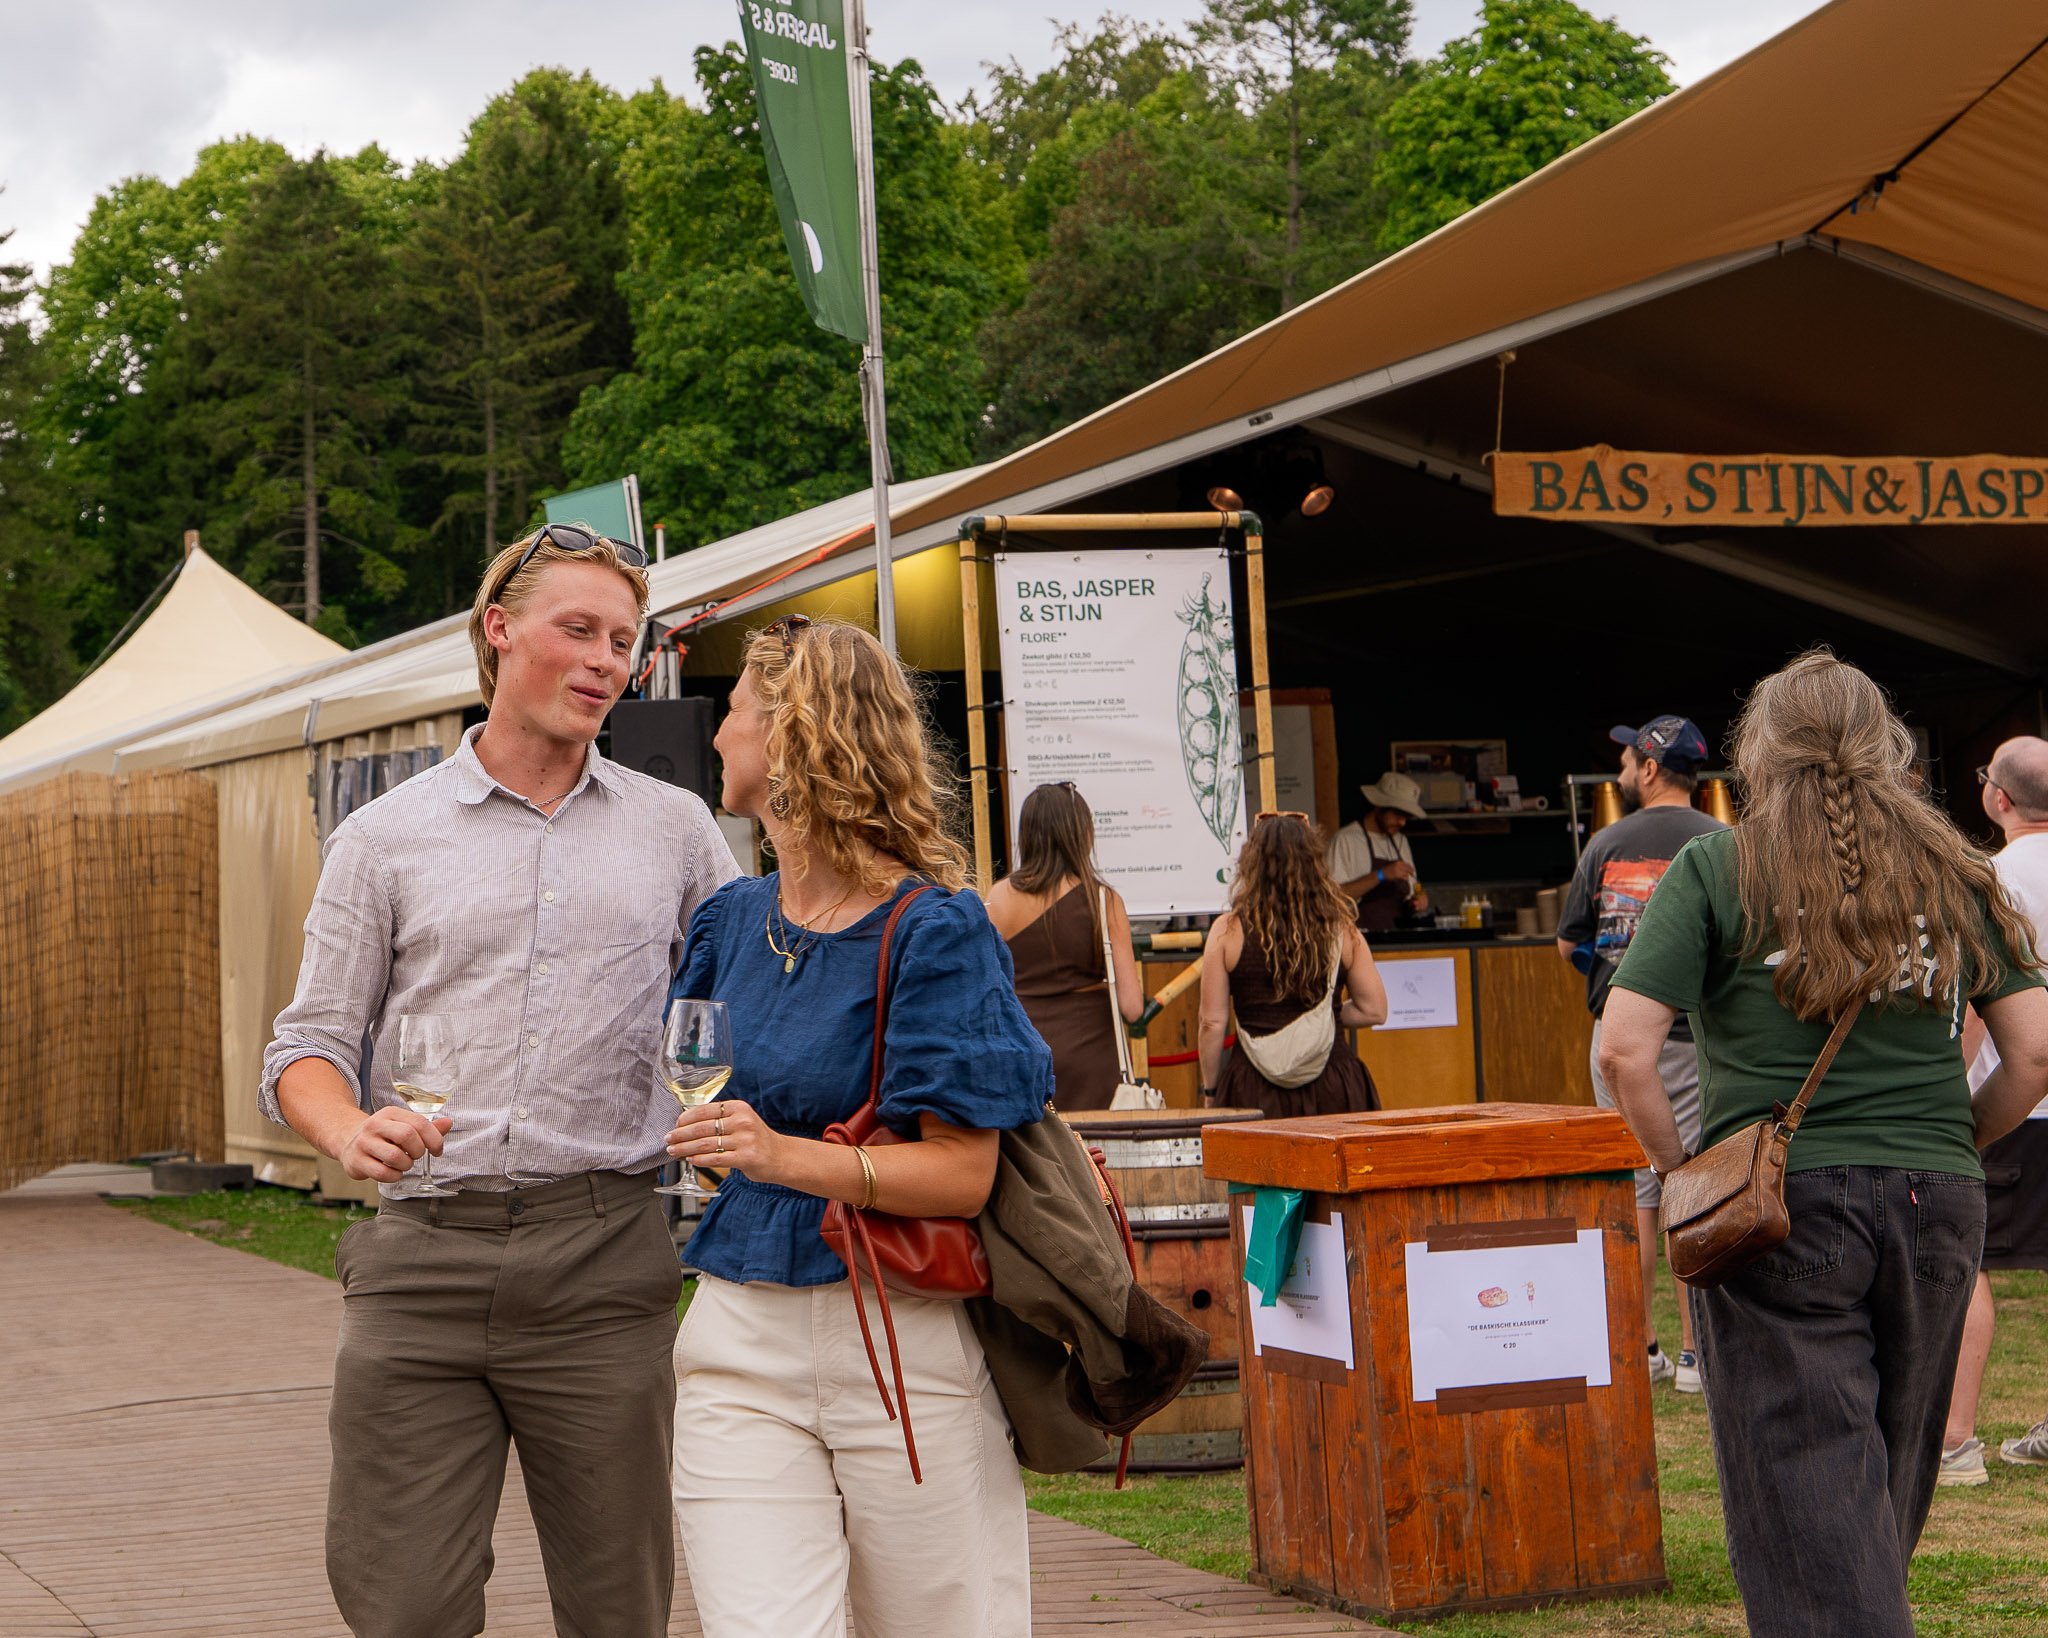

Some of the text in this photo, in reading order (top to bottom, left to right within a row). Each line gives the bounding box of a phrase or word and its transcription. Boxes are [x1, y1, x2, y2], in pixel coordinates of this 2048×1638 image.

[1017, 578, 1156, 600] BAS, JASPER
[1019, 603, 1103, 622] & STIJN
[1479, 1322, 1512, 1330] BASKISCHE
